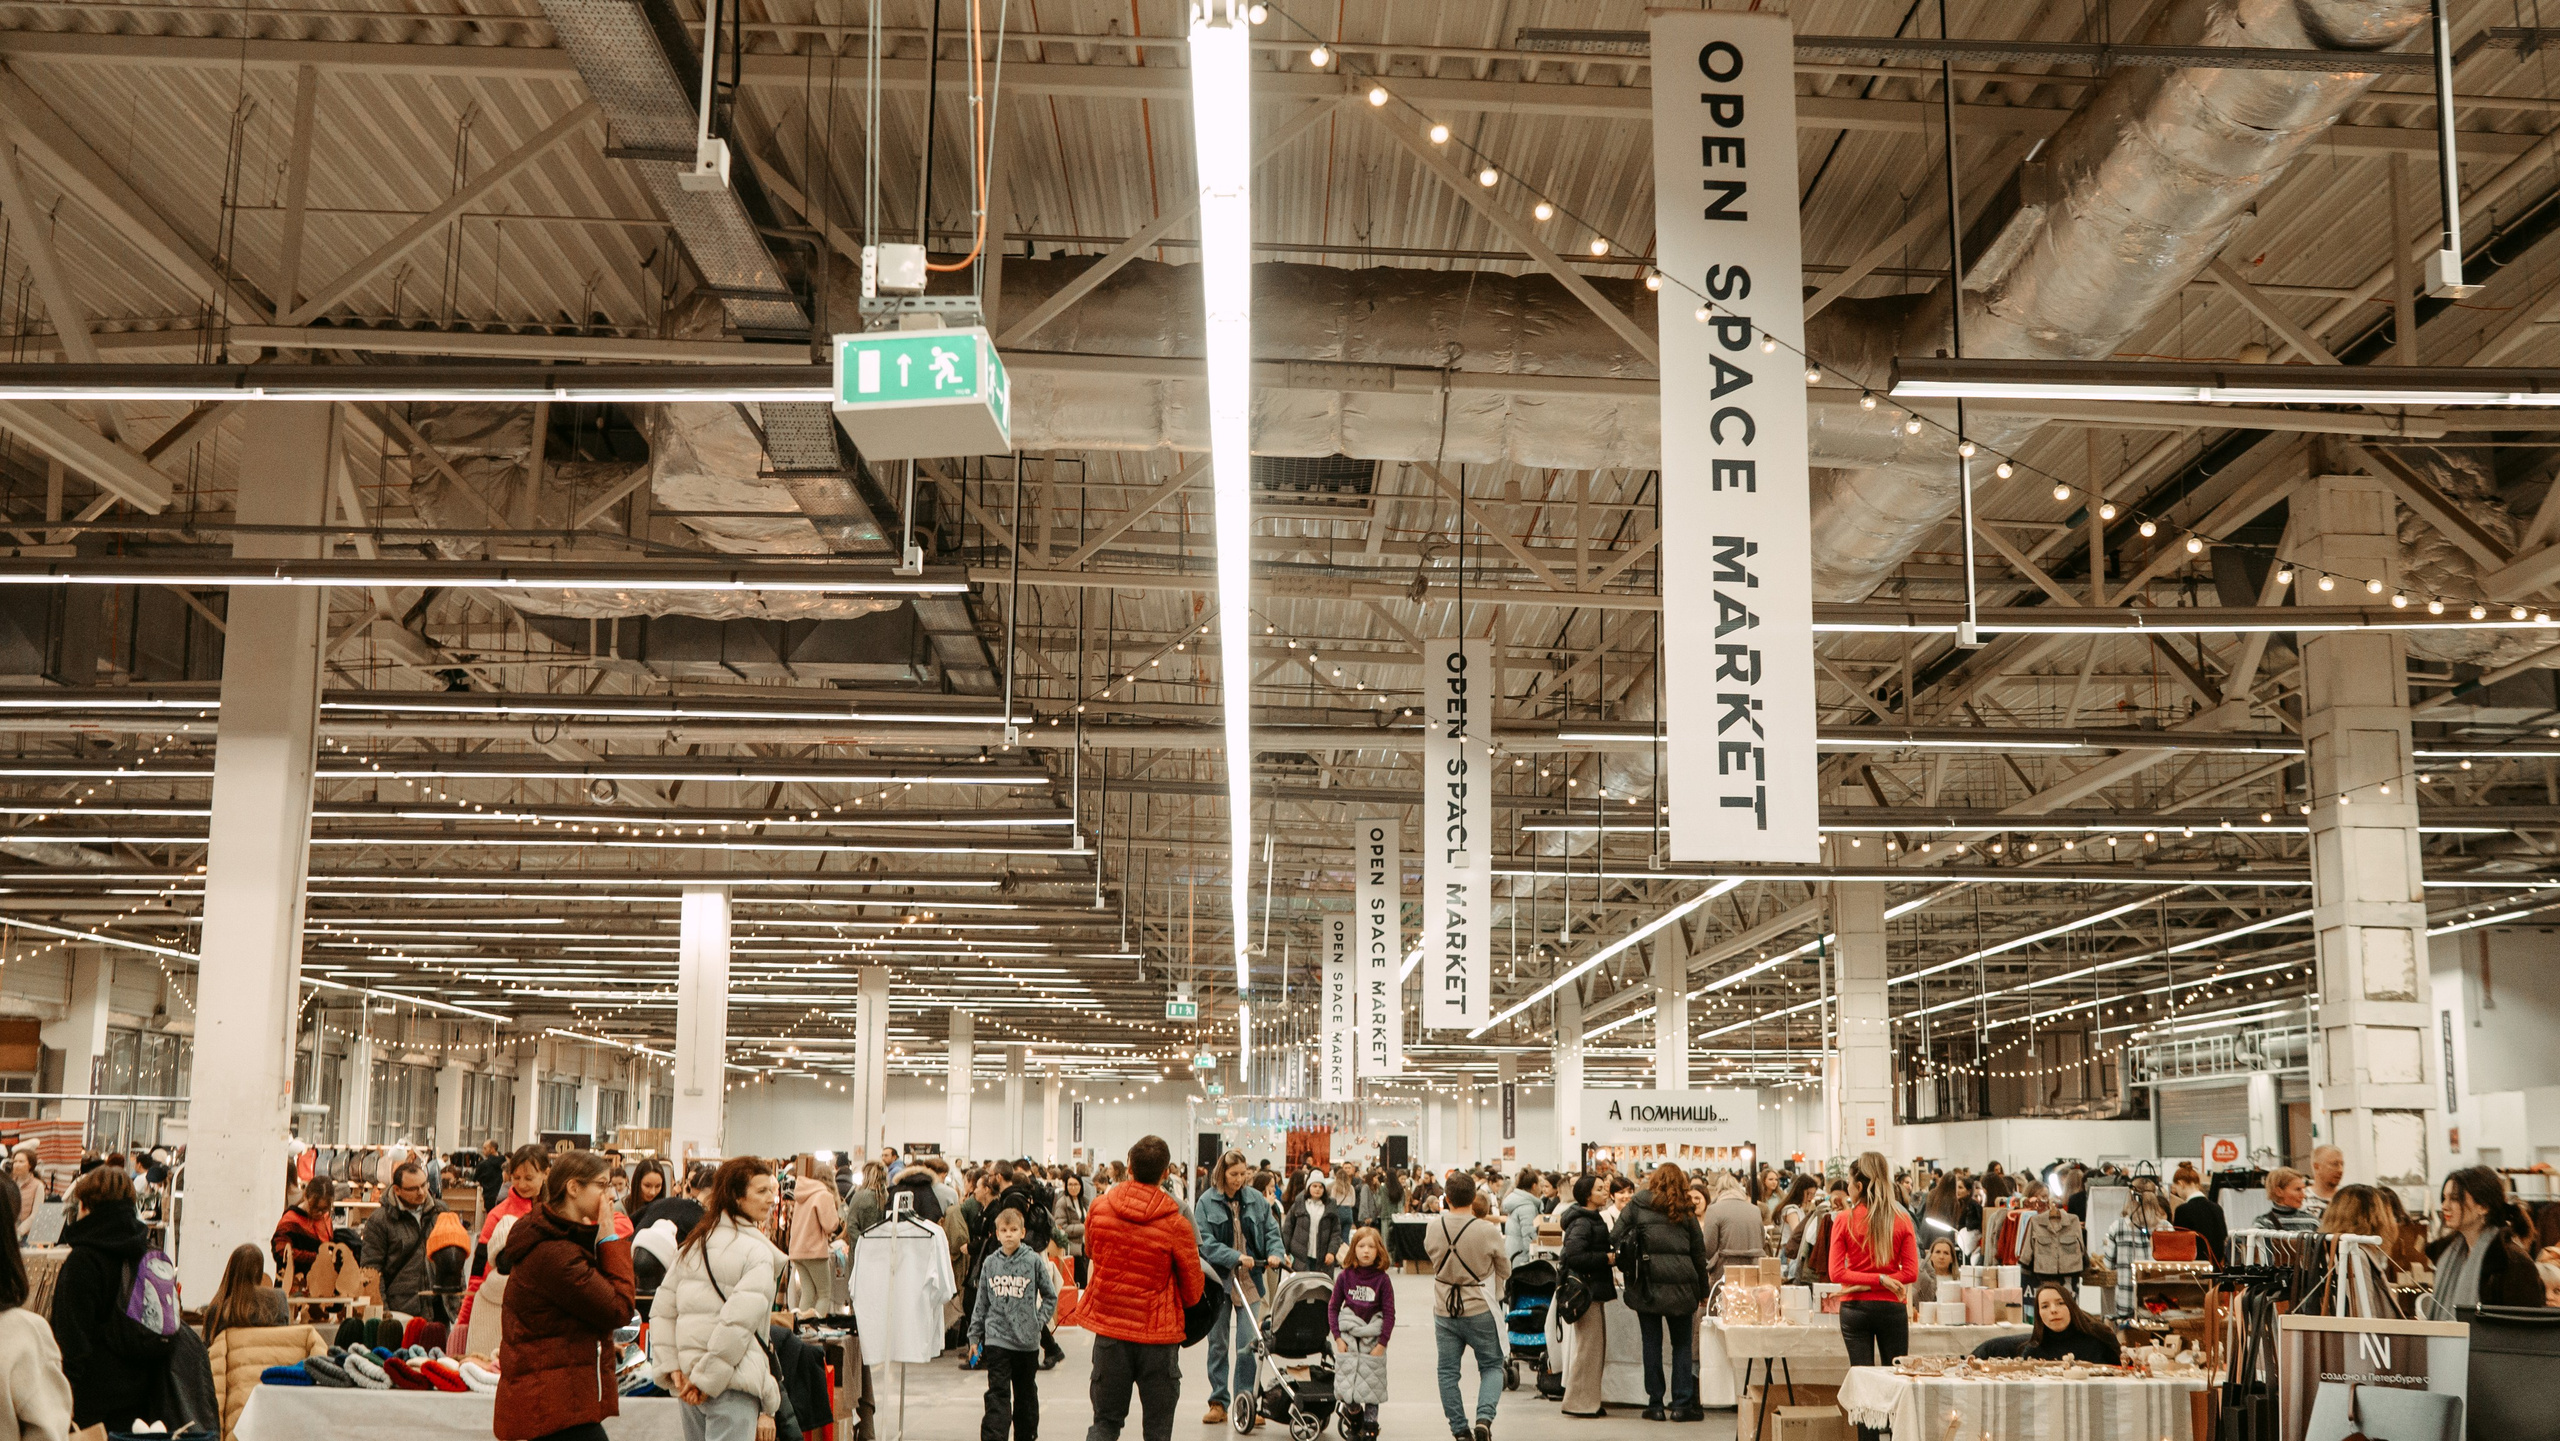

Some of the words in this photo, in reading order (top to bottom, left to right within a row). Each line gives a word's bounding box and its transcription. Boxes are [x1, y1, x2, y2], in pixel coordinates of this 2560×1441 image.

[1698, 40, 1748, 222] OPEN
[1705, 264, 1757, 493] SPACE
[1446, 652, 1468, 739] OPEN
[1712, 535, 1767, 831] MARKET
[1369, 827, 1385, 886] OPEN
[1333, 920, 1344, 963] OPEN
[1370, 898, 1386, 969] SPACE
[1445, 883, 1467, 1015] MARKET
[1332, 972, 1344, 1023] SPACE
[1371, 981, 1387, 1067] MARKET
[1331, 1032, 1342, 1095] MARKET
[1609, 1099, 1622, 1121] А
[1643, 1125, 1693, 1134] ароматических
[1695, 1125, 1718, 1133] свечей
[989, 1275, 1031, 1288] LOONEY
[993, 1286, 1025, 1299] TUNES
[2320, 1372, 2361, 1382] создано
[2368, 1372, 2423, 1384] Петербурге
